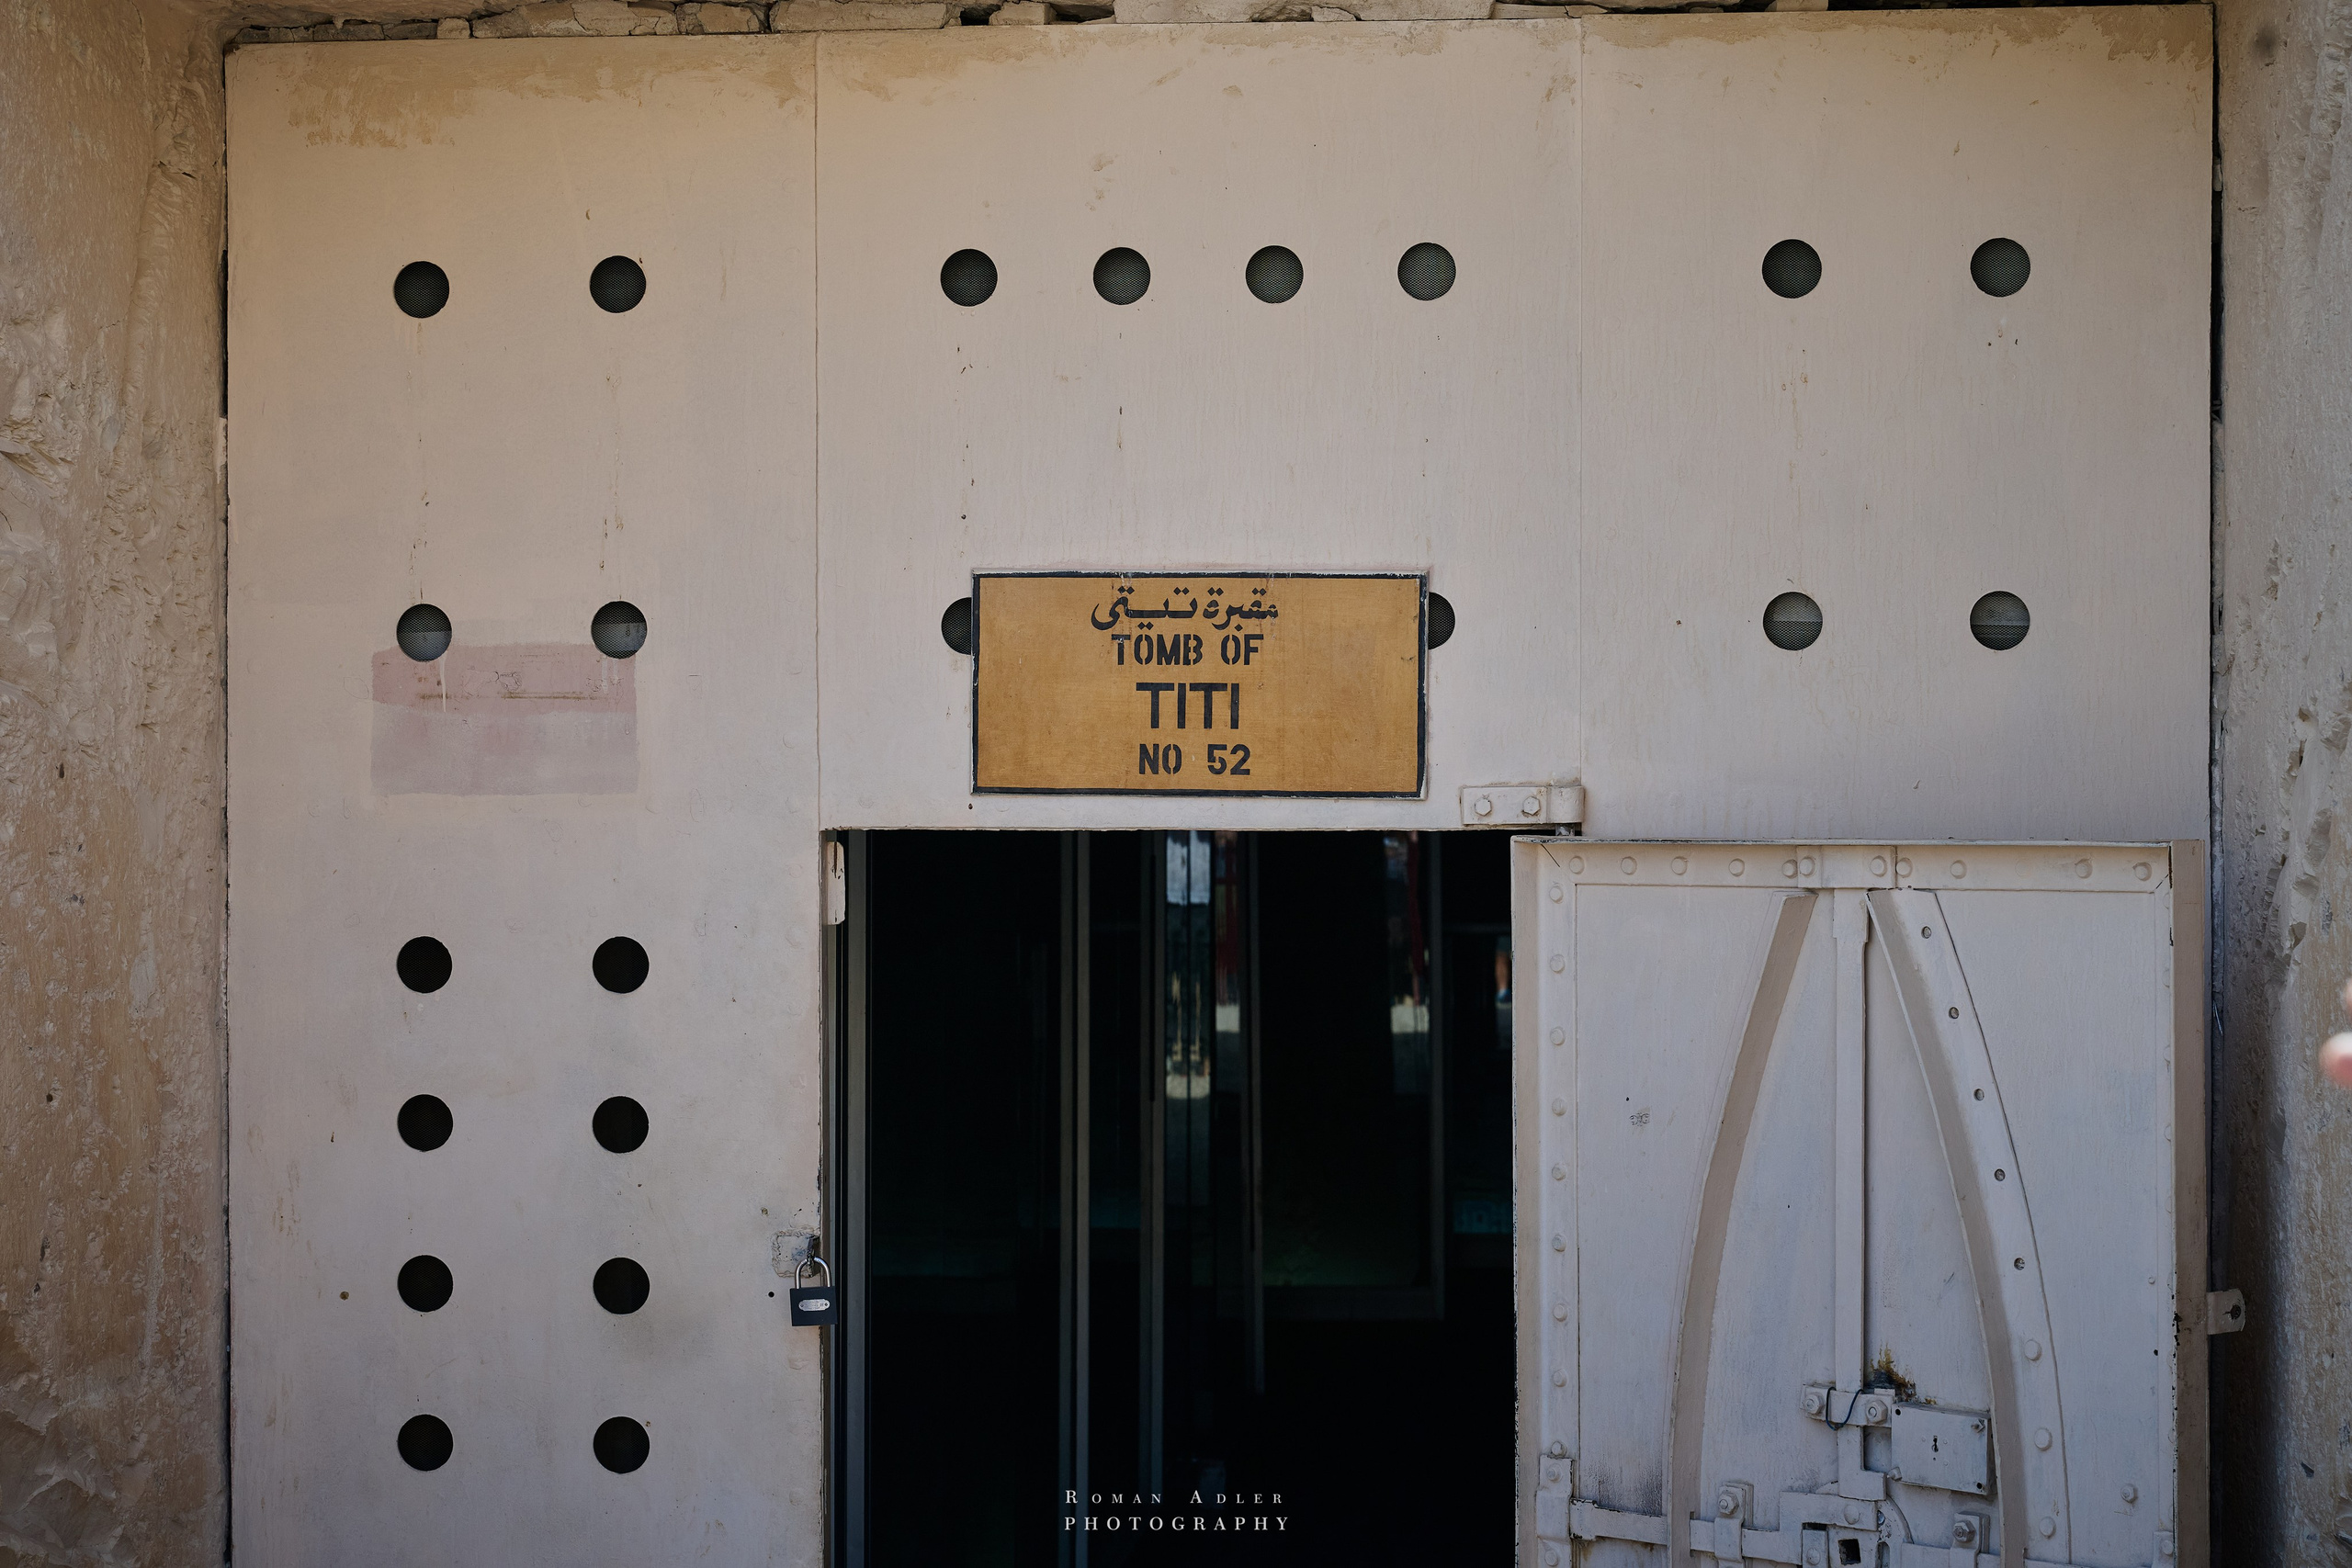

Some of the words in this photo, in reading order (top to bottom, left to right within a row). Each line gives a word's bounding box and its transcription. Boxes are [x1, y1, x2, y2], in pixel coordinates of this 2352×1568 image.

[1203, 586, 1279, 631] مقبرة
[1111, 633, 1204, 666] TOMB
[1220, 633, 1264, 666] OF
[1136, 682, 1240, 730] TITI
[1138, 743, 1182, 775] NO
[1207, 743, 1251, 776] 52
